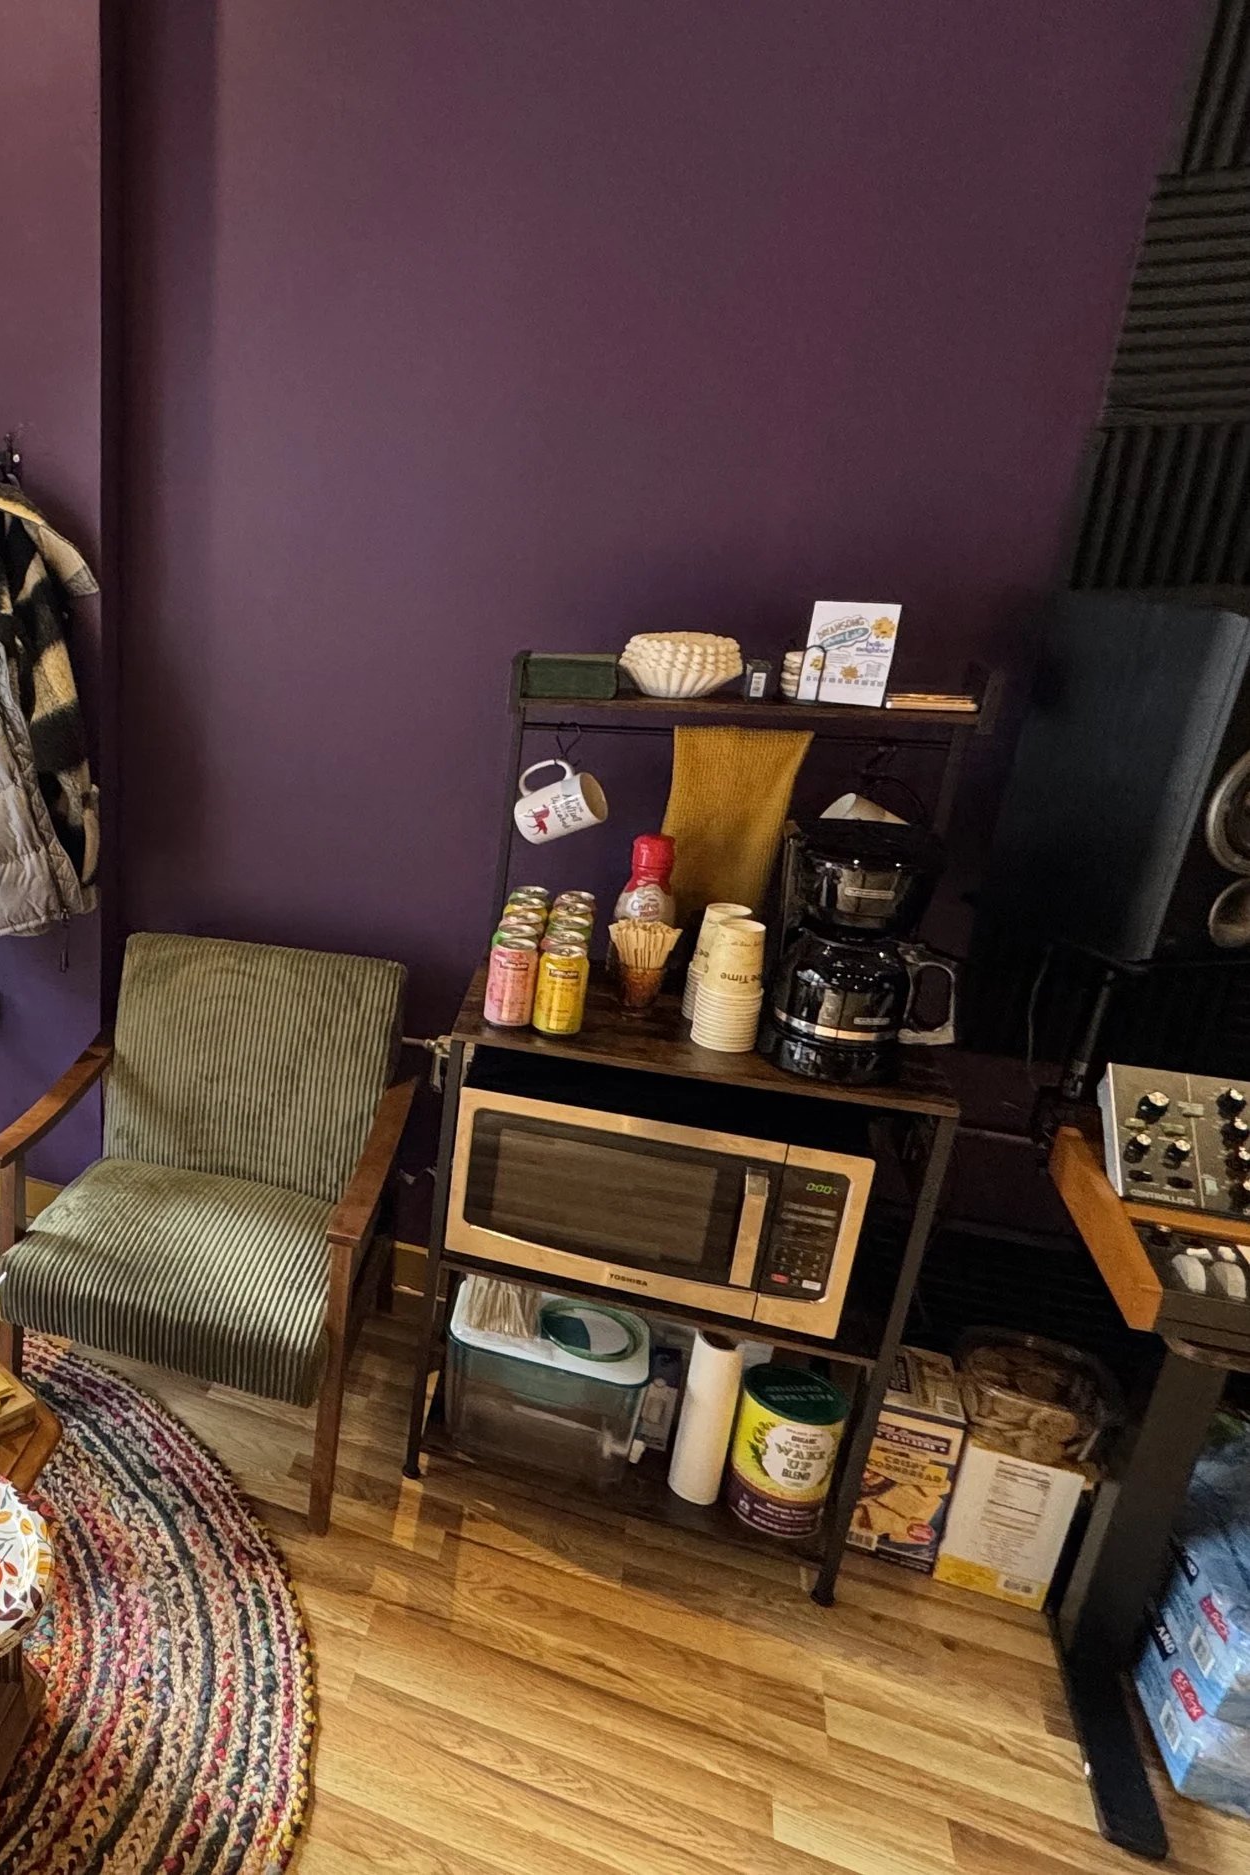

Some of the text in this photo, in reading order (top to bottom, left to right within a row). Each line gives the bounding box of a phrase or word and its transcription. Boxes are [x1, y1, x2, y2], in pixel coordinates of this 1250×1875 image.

[720, 972, 750, 985] Time
[609, 1273, 648, 1287] TOSHIBA
[775, 1442, 826, 1460] WAKE
[786, 1458, 813, 1471] UP
[782, 1468, 811, 1481] BLEND
